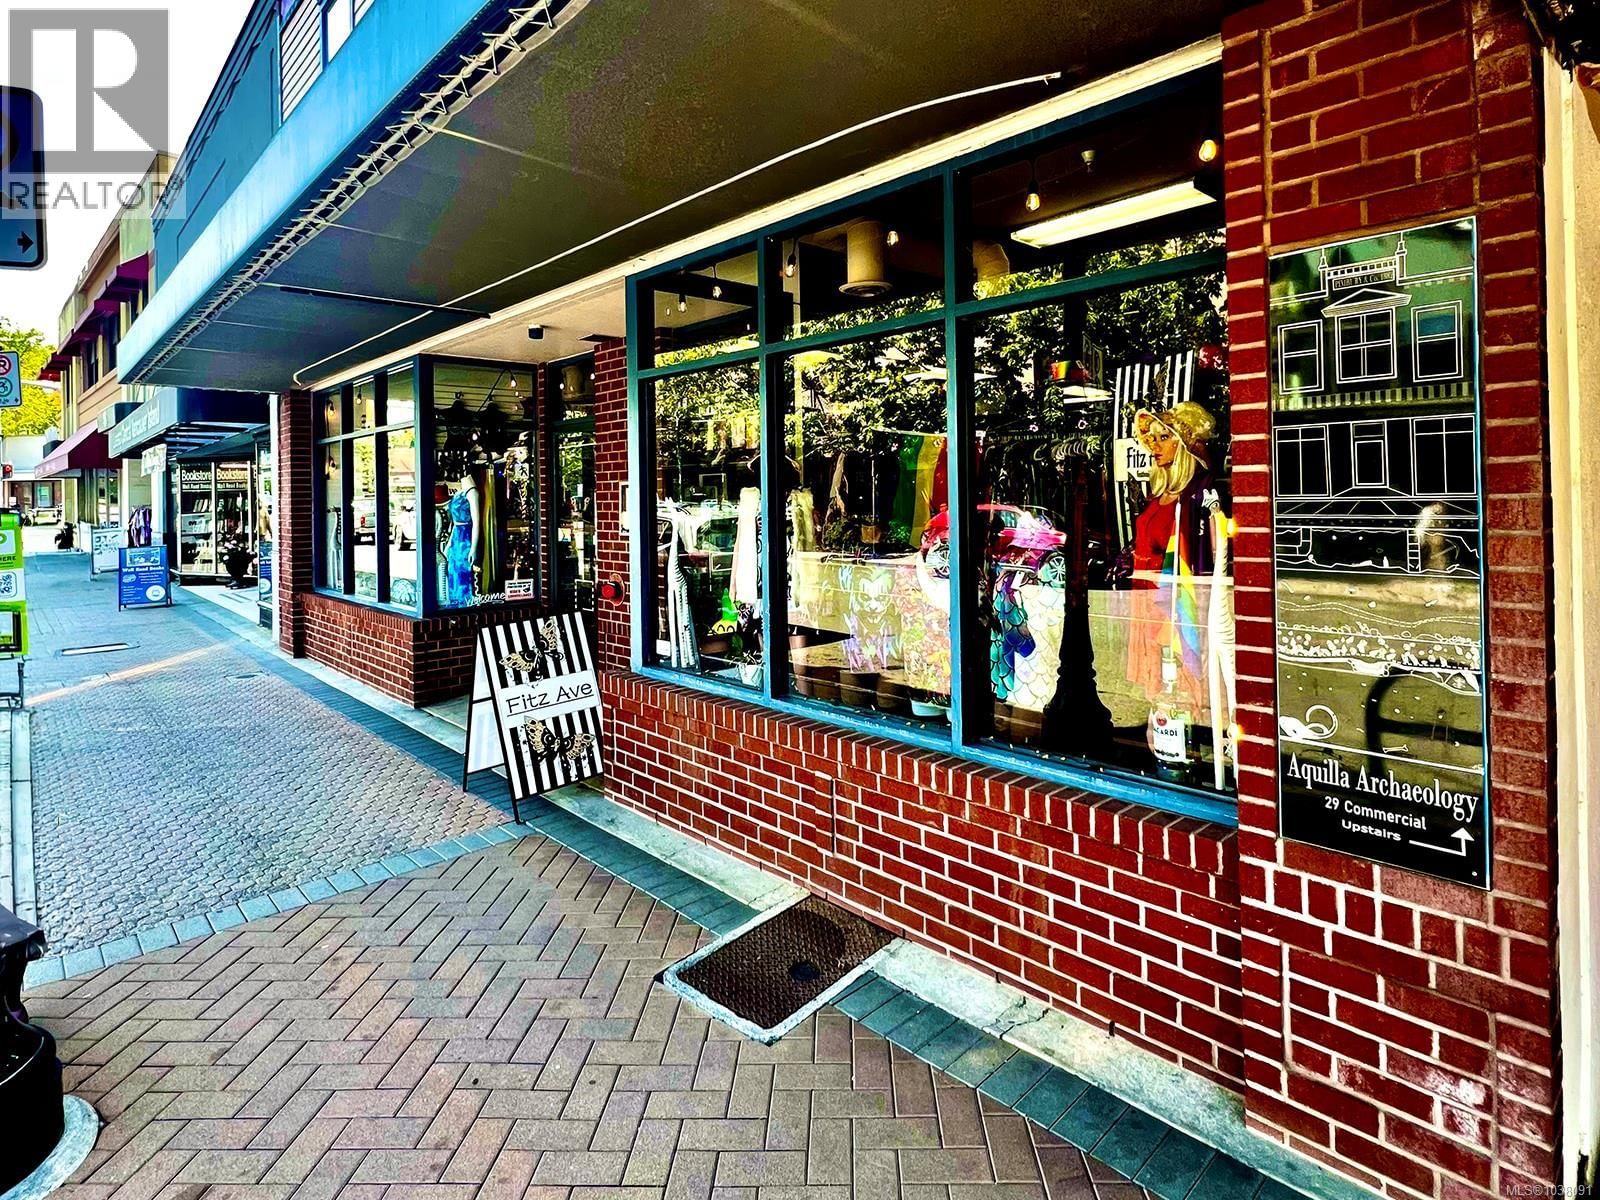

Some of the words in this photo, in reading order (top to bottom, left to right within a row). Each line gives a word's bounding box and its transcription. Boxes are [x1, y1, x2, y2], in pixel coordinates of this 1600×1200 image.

[182, 469, 212, 481] Bookstore
[216, 468, 248, 480] Bookstore
[505, 692, 550, 714] Fitz
[556, 682, 593, 702] Ave
[1287, 751, 1350, 789] Aquilla
[1355, 765, 1479, 823] Archaeology
[1324, 796, 1340, 810] 29
[1344, 799, 1428, 831] Commercial
[1341, 819, 1402, 841] Upstairs
